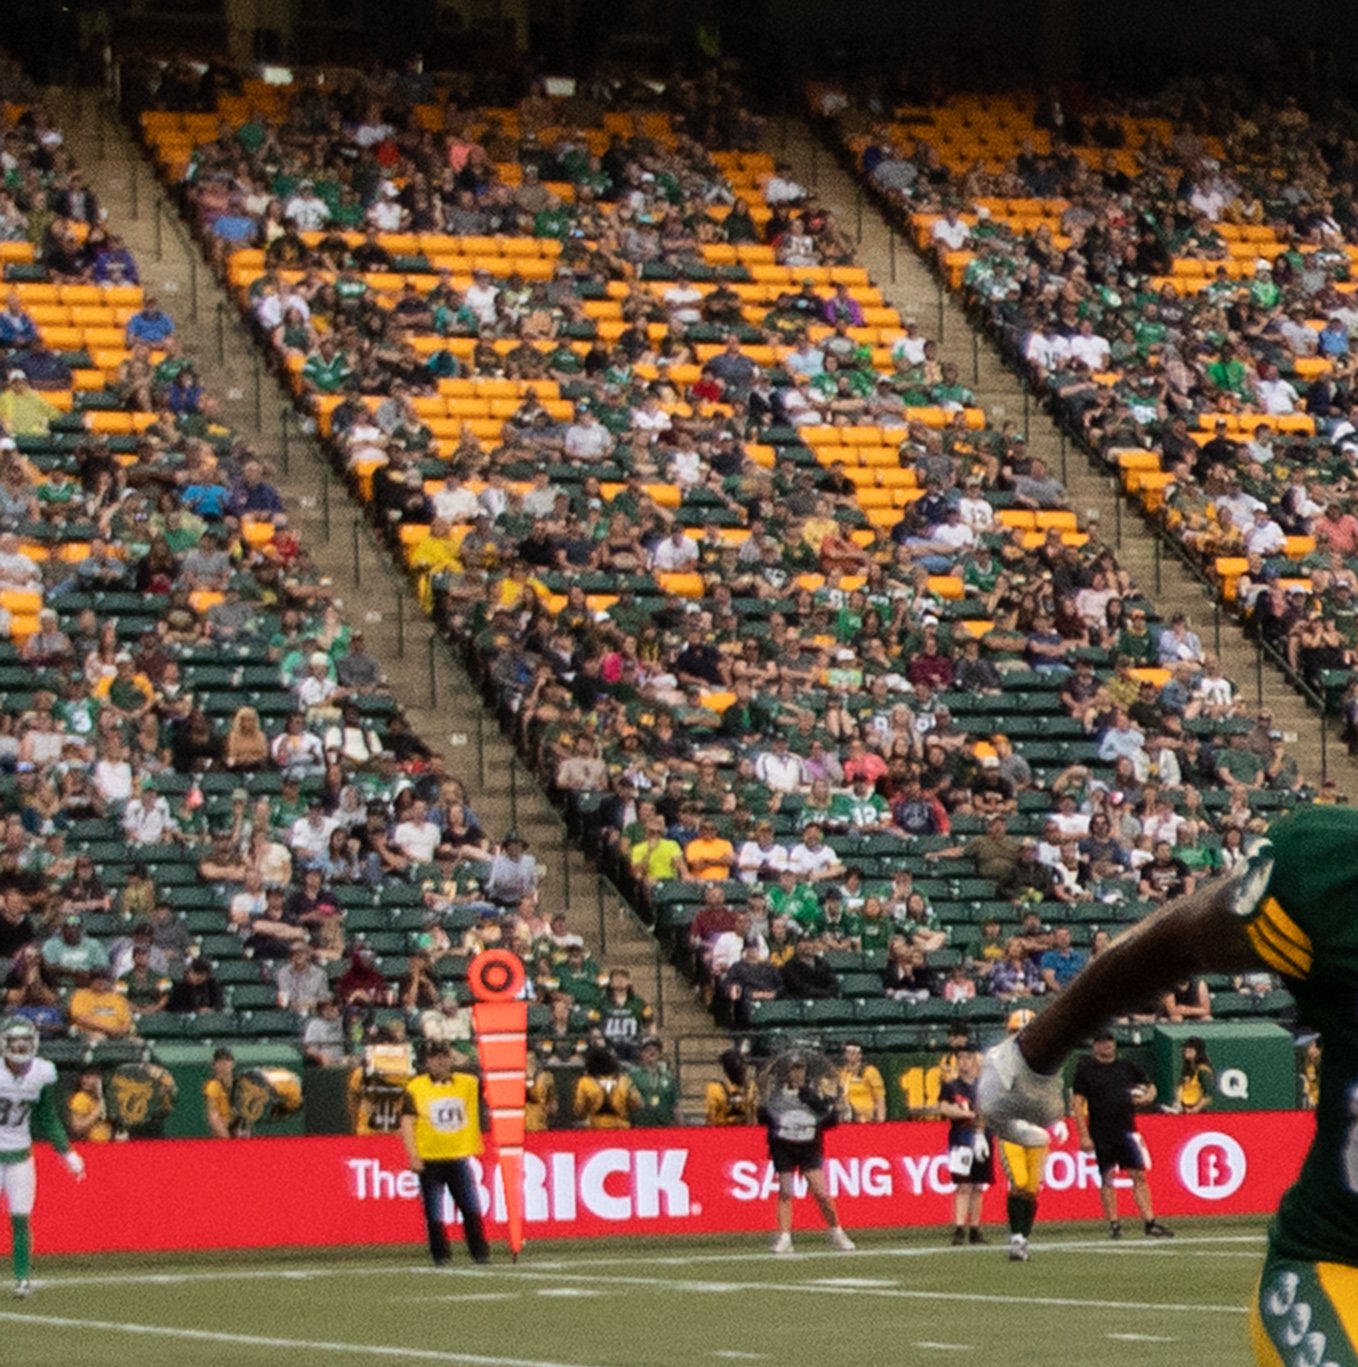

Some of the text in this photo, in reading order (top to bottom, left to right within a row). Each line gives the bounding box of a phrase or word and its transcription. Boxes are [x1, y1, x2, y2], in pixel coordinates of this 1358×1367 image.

[1219, 1068, 1249, 1100] Q
[348, 1157, 420, 1200] The
[731, 1157, 893, 1200] SANG
